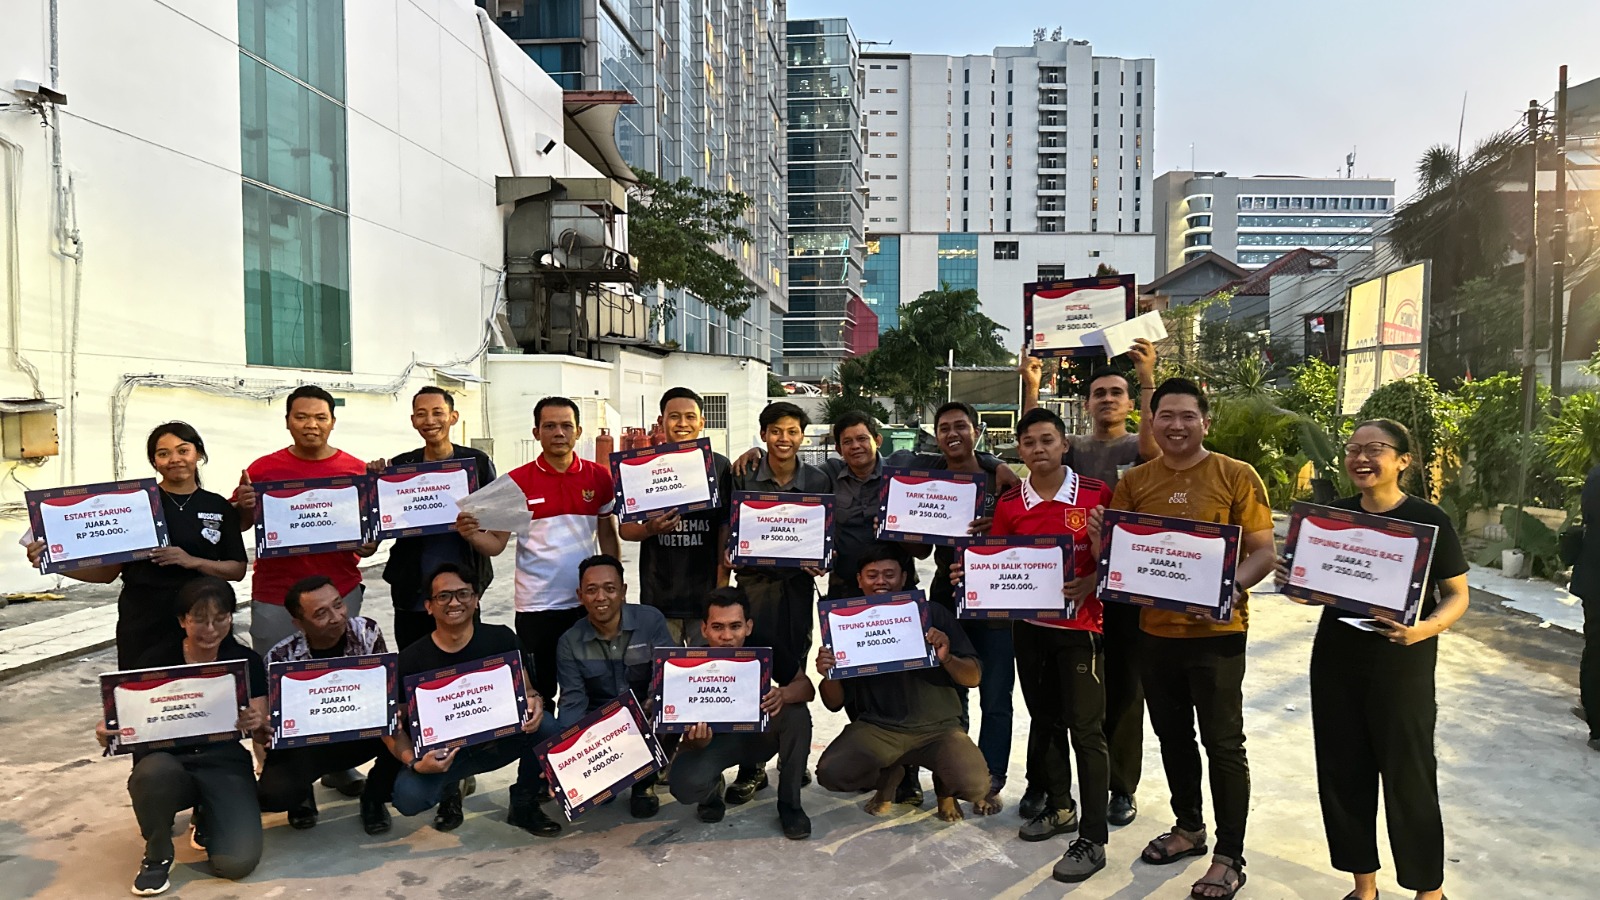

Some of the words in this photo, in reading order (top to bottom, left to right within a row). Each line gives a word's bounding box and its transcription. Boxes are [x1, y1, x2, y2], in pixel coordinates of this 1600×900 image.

[418, 485, 450, 493] TAMBANG
[655, 483, 686, 492] 250.000,-
[925, 493, 958, 502] TAMBANG
[290, 502, 332, 511] BADMINTON
[414, 503, 447, 511] 500.000,-
[64, 511, 96, 520] ESTAFET
[99, 507, 131, 516] SARUNG
[919, 511, 951, 519] 250.000,-
[85, 520, 110, 528] JUARA
[90, 528, 129, 538] 250.000,-
[658, 534, 703, 546] VOETBAL
[1132, 544, 1164, 554] ESTAFET
[1166, 548, 1201, 560] SARUNG
[1308, 536, 1341, 549] TEPUNG
[1342, 543, 1378, 557] KARDUS
[1380, 551, 1404, 563] RACE
[1149, 559, 1176, 568] JUARA
[1333, 554, 1362, 566] JUARA
[1149, 569, 1191, 581] 500.000,-
[1321, 563, 1333, 572] RP
[1335, 566, 1378, 582] 250.000,-
[838, 622, 865, 631] TEPUNG
[867, 619, 893, 628] KARDUS
[867, 638, 900, 646] 500.000,-
[309, 684, 360, 695] PLAYSTATION
[437, 691, 465, 703] TANCAP
[467, 684, 493, 696] PULPEN
[150, 692, 203, 703] BADMINTON
[322, 706, 361, 714] 500.000,-
[452, 700, 475, 710] JUARA
[161, 711, 211, 722] 1.000.000,-
[456, 706, 492, 718] 250.000,-
[558, 755, 576, 770] SIAPA
[577, 751, 584, 759] DI
[584, 740, 601, 754] BALIK
[602, 723, 631, 744] TOPENG?
[588, 751, 606, 765] JUARA
[583, 769, 592, 778] RP
[593, 752, 624, 773] 500.000,-
